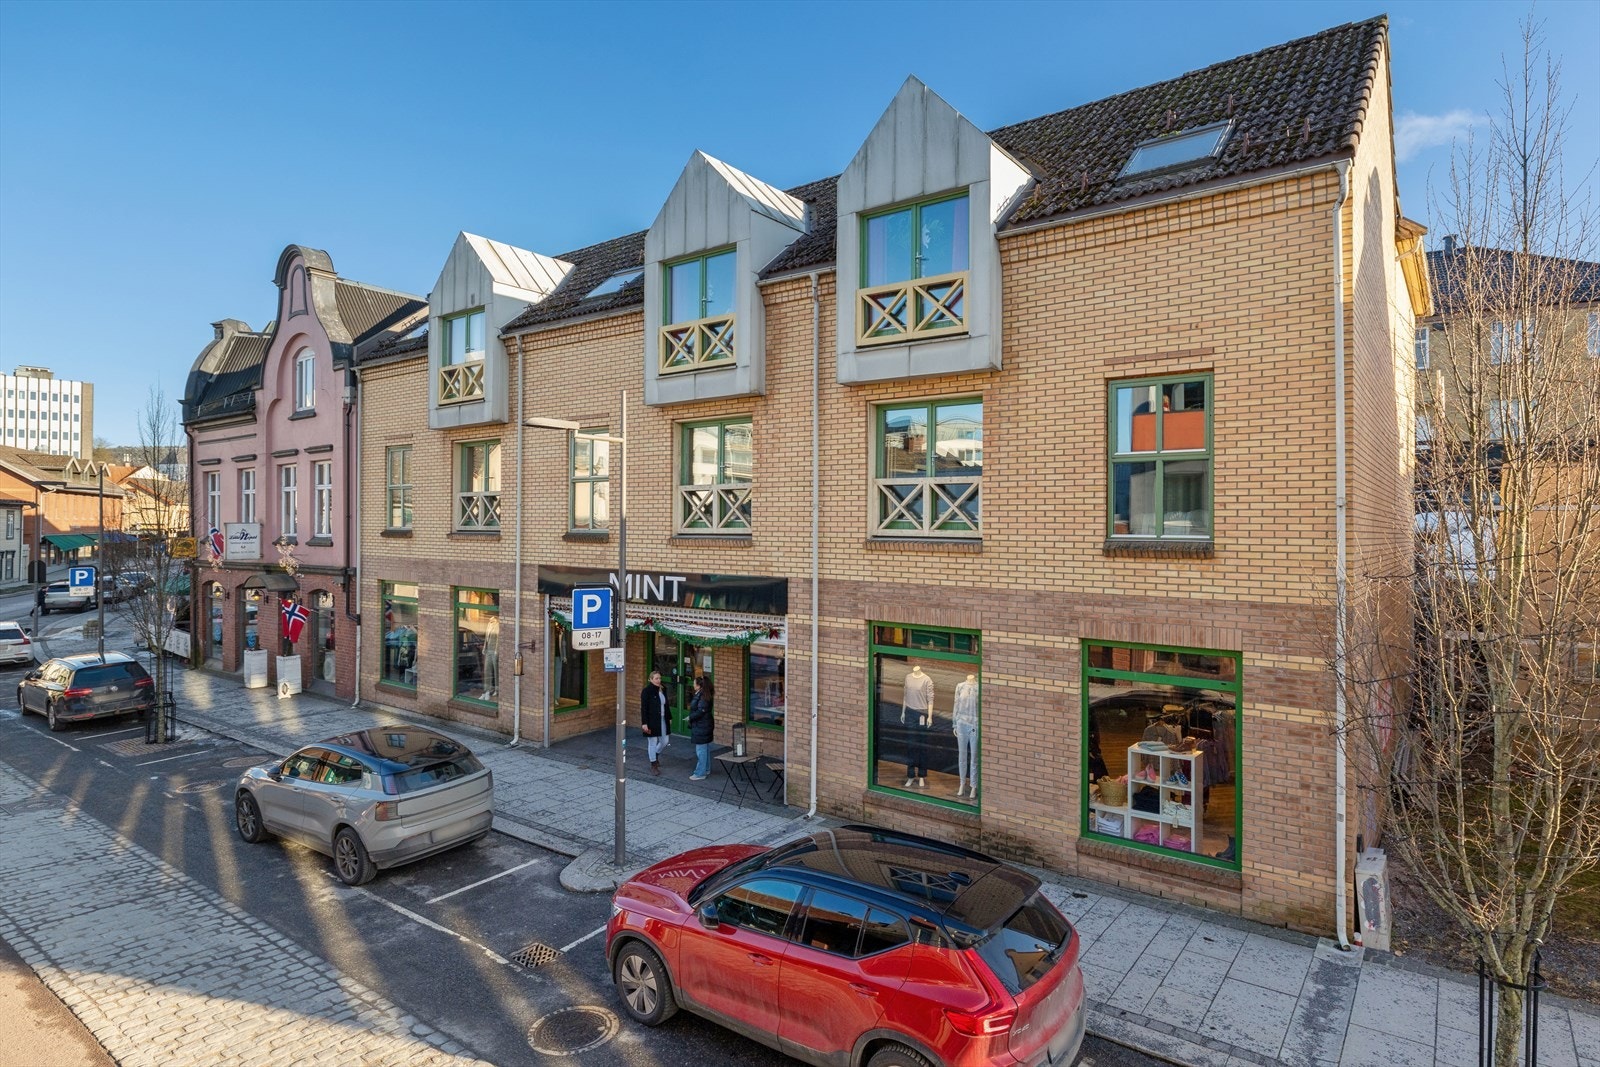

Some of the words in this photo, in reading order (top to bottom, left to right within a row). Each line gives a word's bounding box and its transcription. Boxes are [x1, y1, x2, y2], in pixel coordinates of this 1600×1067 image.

[75, 570, 89, 585] P
[609, 572, 686, 602] MINT
[582, 594, 602, 625] P
[581, 631, 602, 639] 08-17
